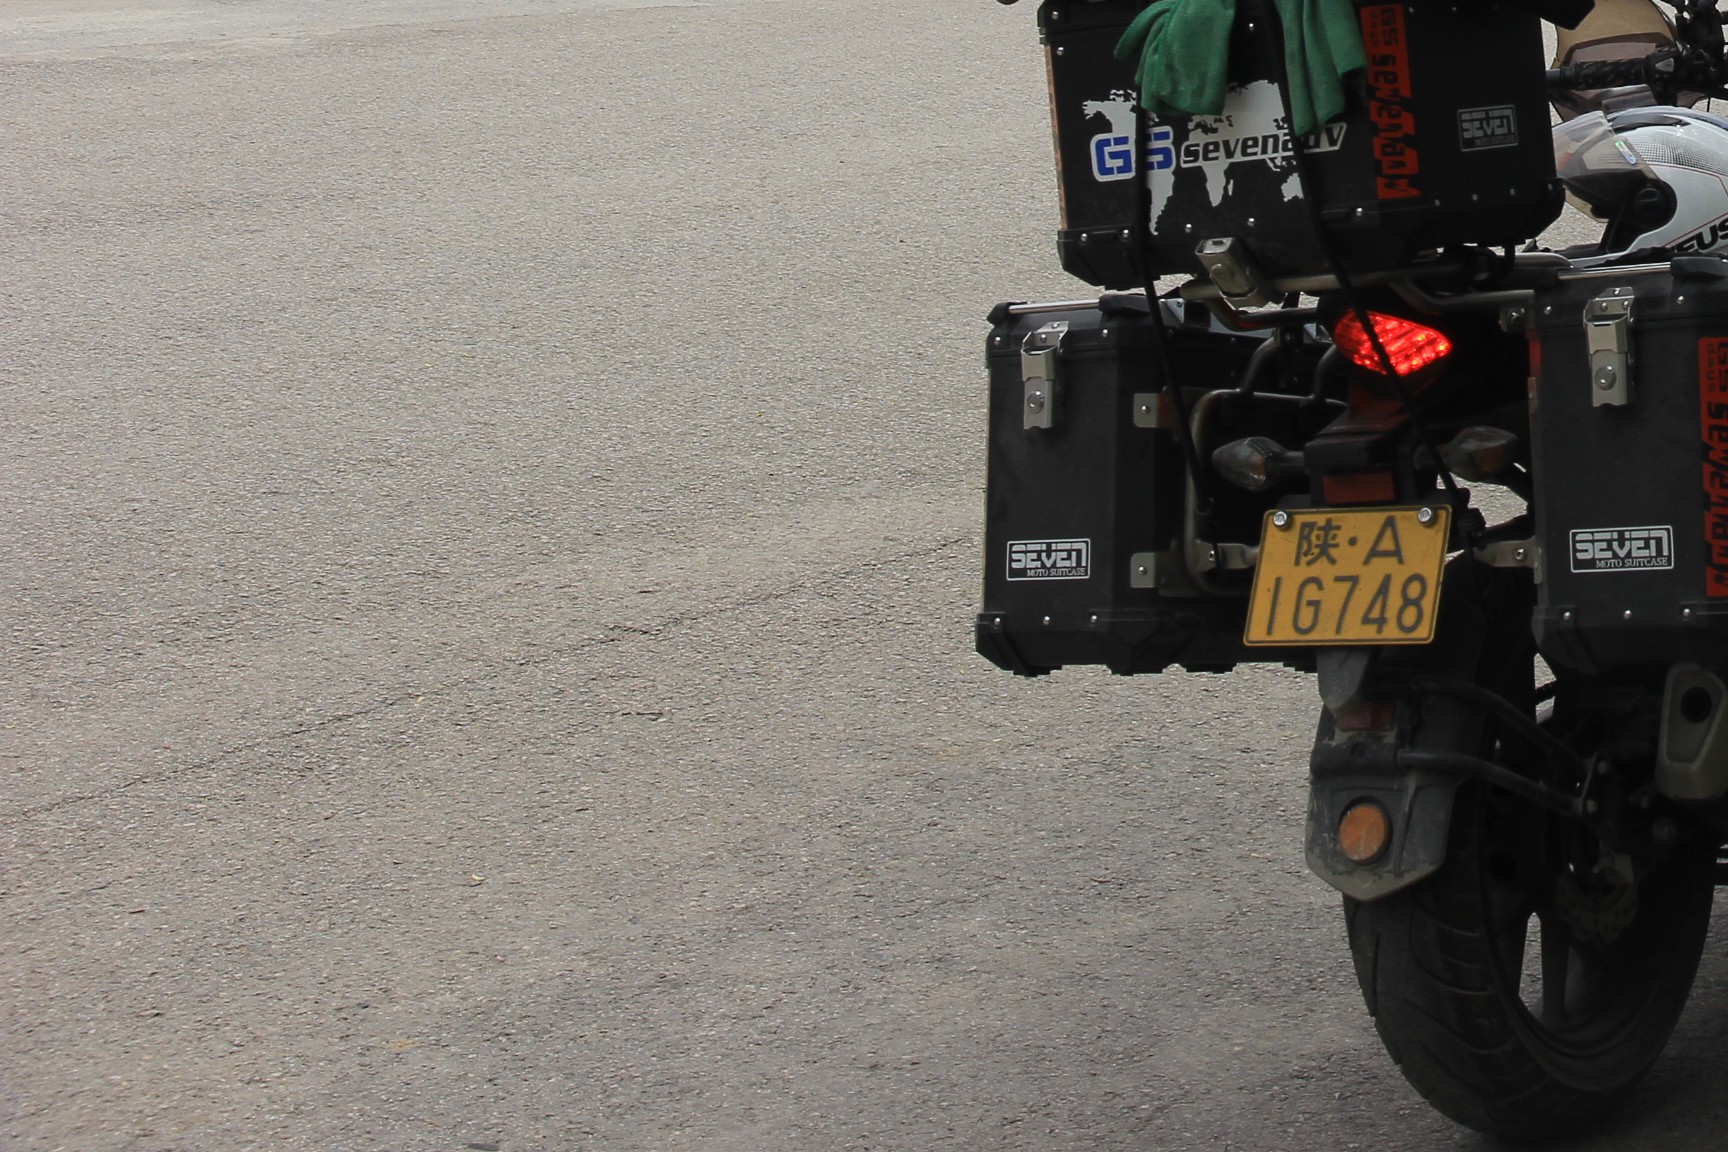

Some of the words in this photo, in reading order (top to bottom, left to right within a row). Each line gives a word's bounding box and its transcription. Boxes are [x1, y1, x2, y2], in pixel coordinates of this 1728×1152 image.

[1575, 530, 1669, 560] SEVEN
[1011, 544, 1088, 569] SEVEN
[1596, 559, 1622, 569] MOTO
[1624, 557, 1668, 568] SUITCASE
[1027, 569, 1048, 577] MOTO
[1050, 567, 1086, 576] SUITCASE
